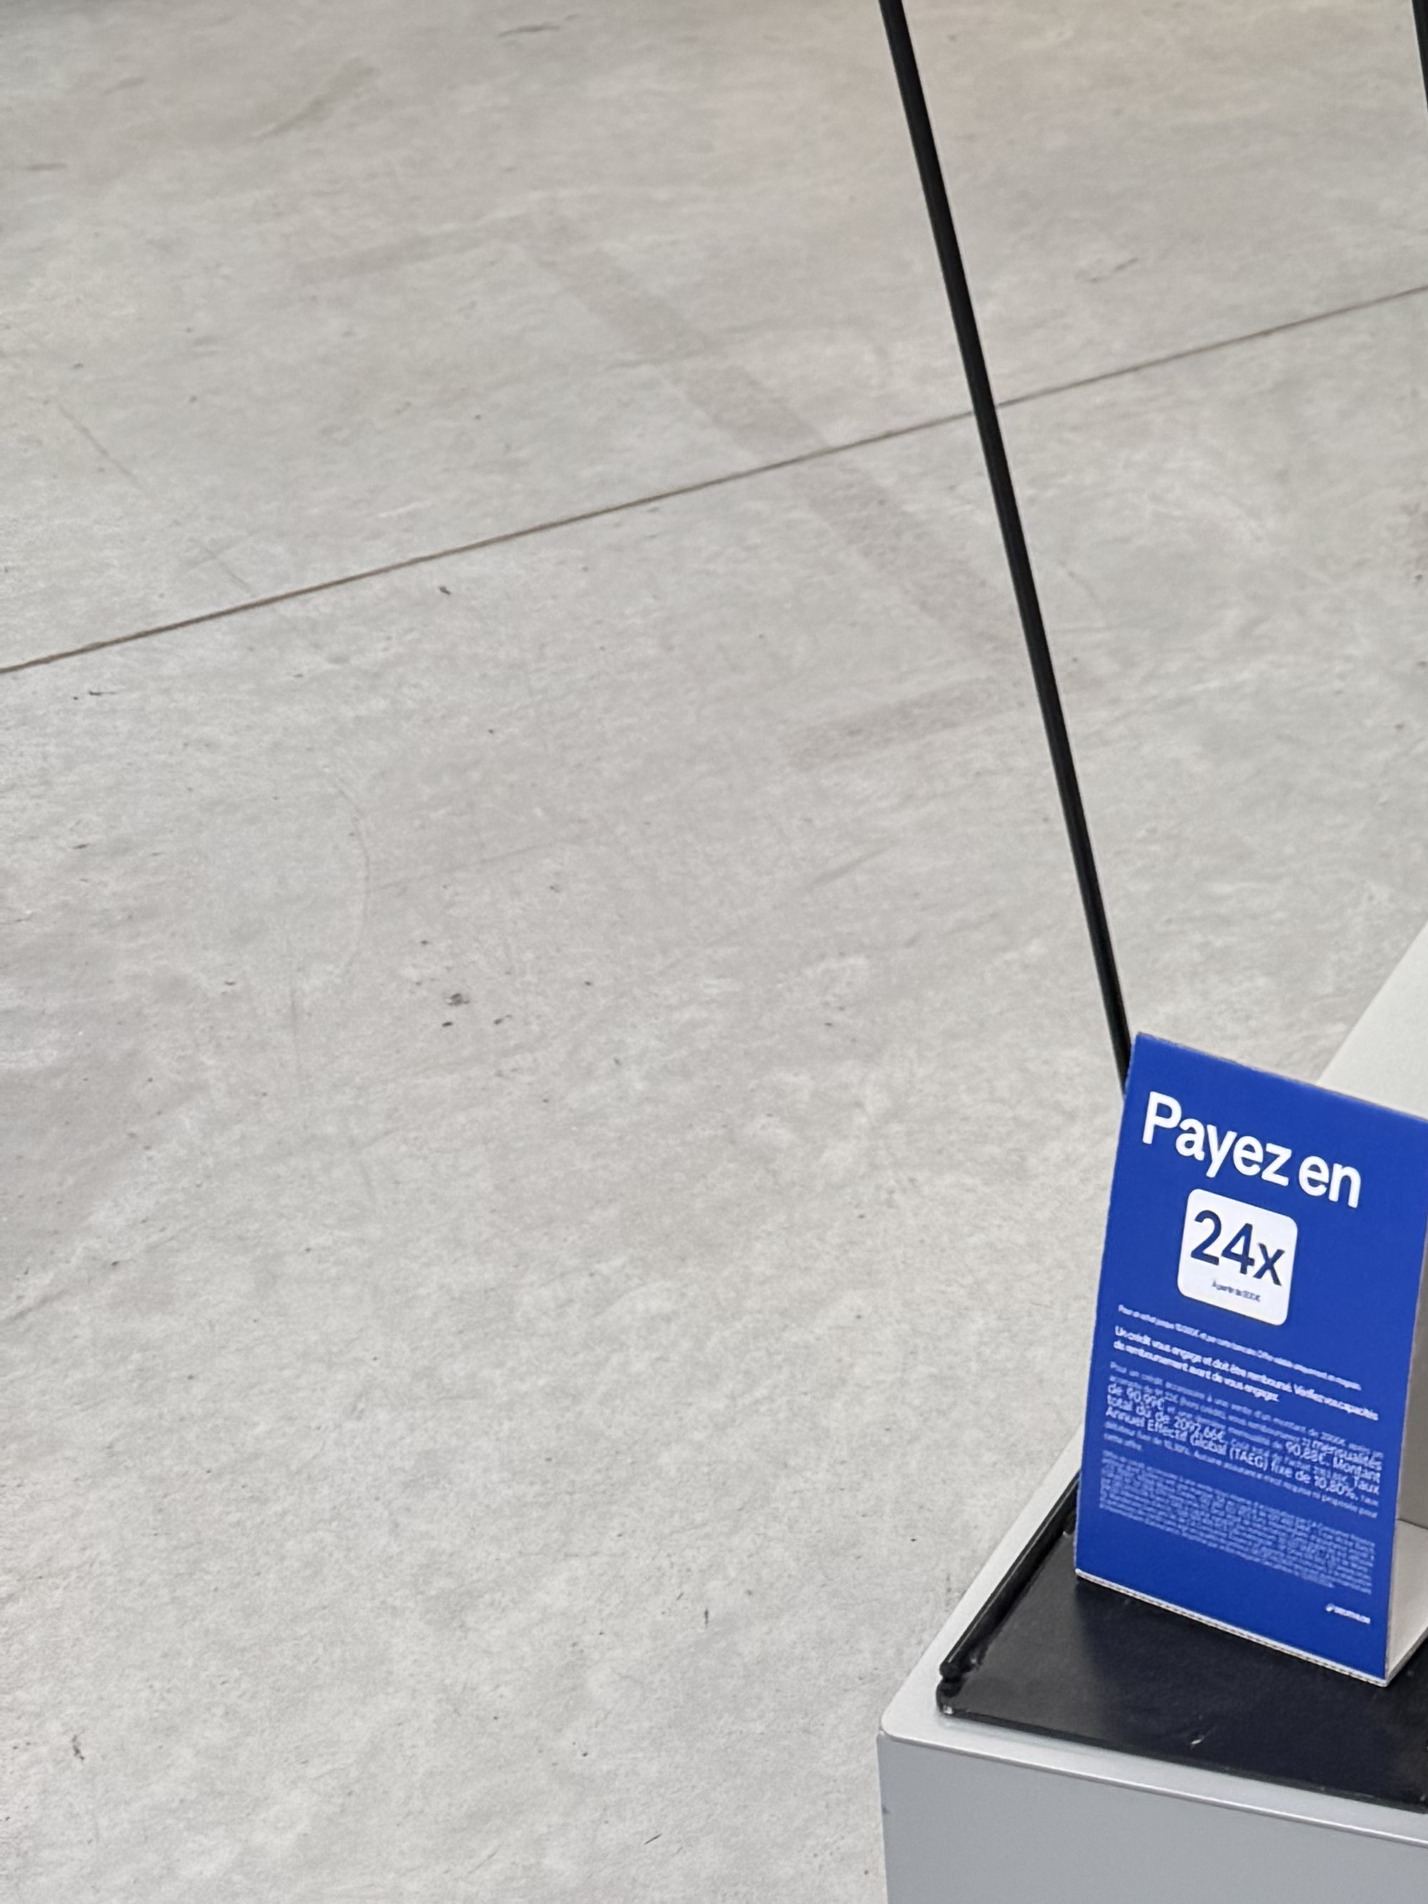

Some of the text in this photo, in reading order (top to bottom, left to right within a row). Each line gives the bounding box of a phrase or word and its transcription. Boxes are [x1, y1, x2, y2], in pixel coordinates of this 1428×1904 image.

[1142, 1091, 1362, 1209] Payez en
[1190, 1209, 1286, 1287] 24x
